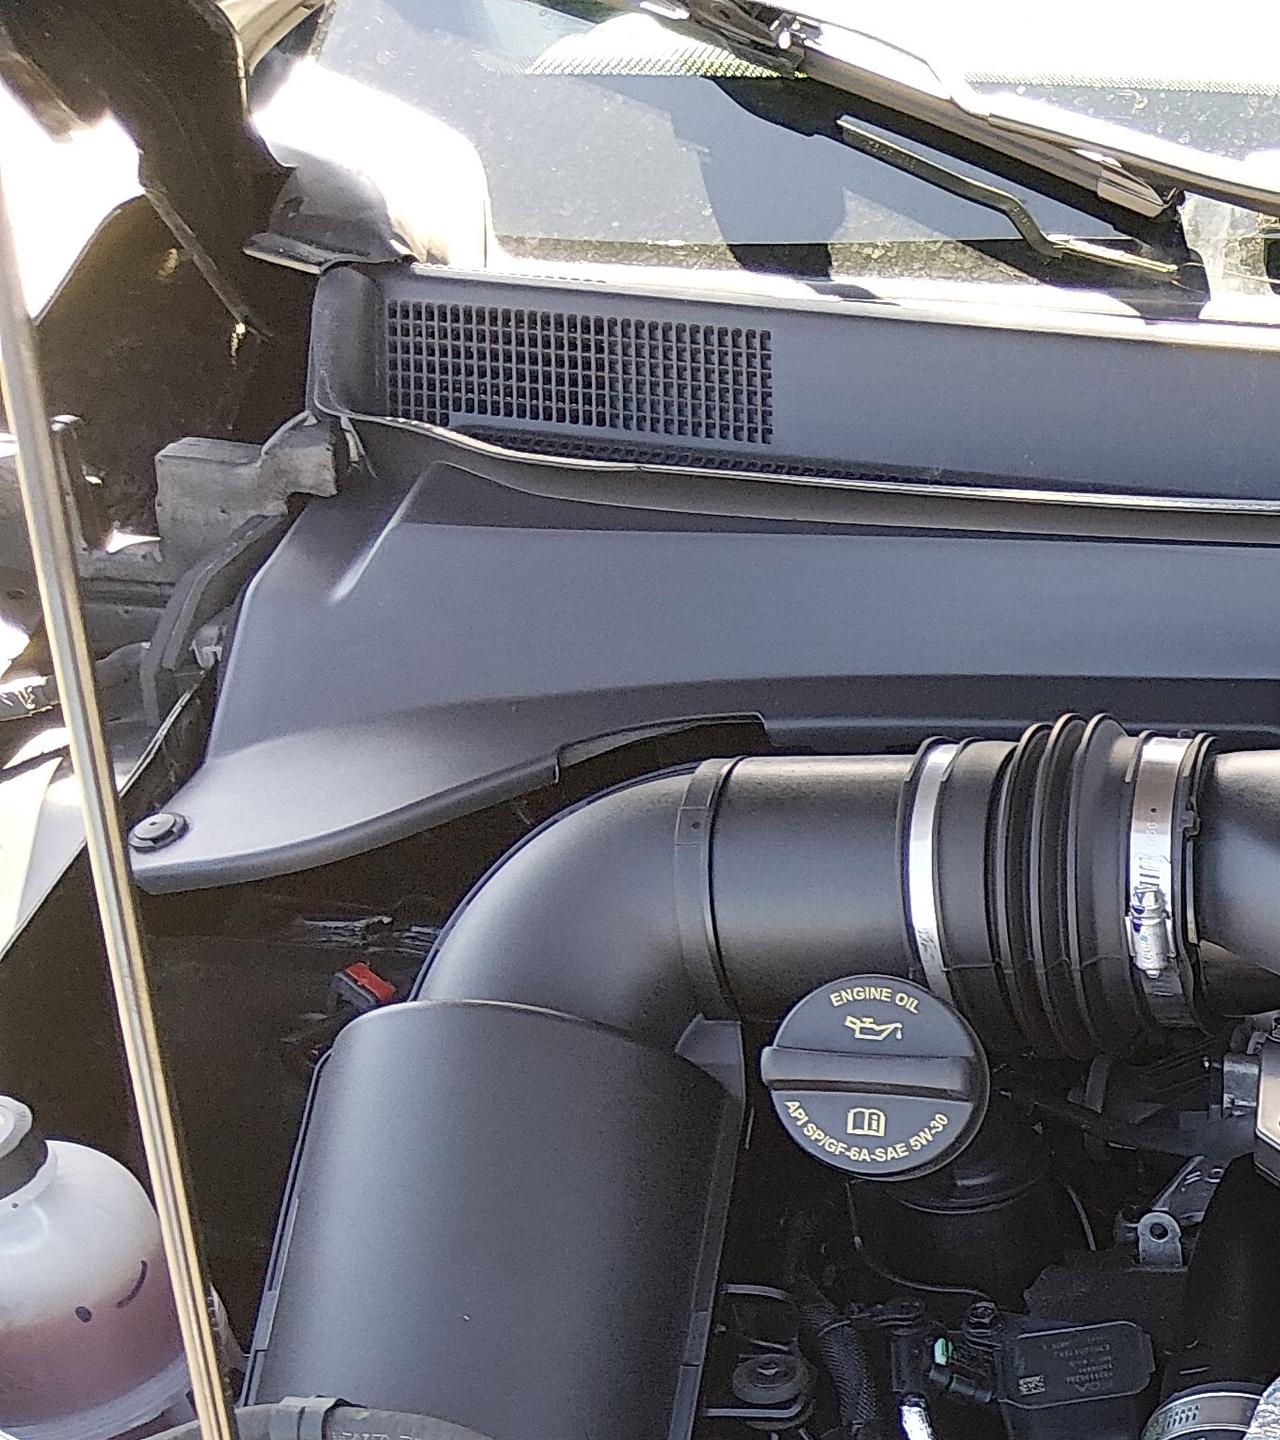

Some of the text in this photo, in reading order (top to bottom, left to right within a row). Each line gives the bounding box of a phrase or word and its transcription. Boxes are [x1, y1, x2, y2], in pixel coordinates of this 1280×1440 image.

[829, 987, 920, 1014] ENGINE OIL
[784, 1101, 803, 1126] API
[910, 1113, 949, 1151] 5W-30
